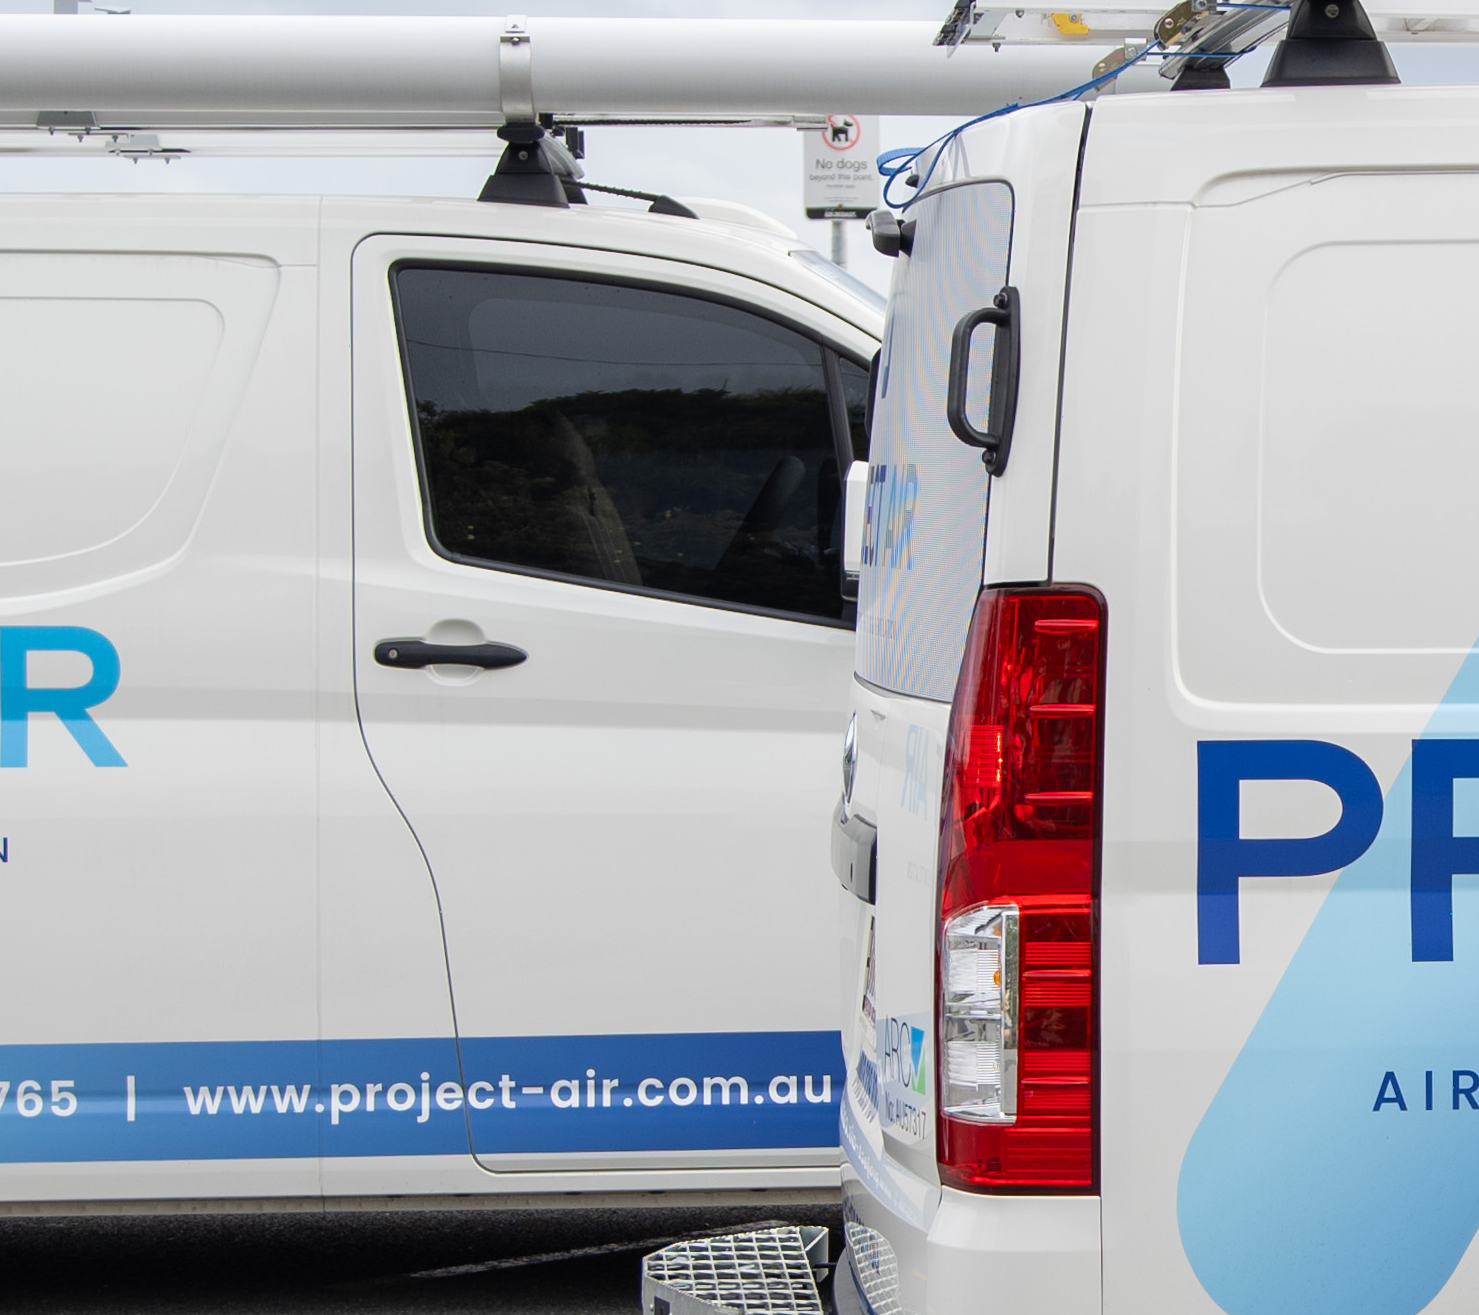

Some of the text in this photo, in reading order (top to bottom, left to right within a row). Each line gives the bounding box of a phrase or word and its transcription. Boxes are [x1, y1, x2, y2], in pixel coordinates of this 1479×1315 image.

[809, 174, 836, 182] beyond
[815, 158, 867, 172] No dogs
[884, 1015, 911, 1088] ARC
[183, 1069, 832, 1125] www.project-air.com.au
